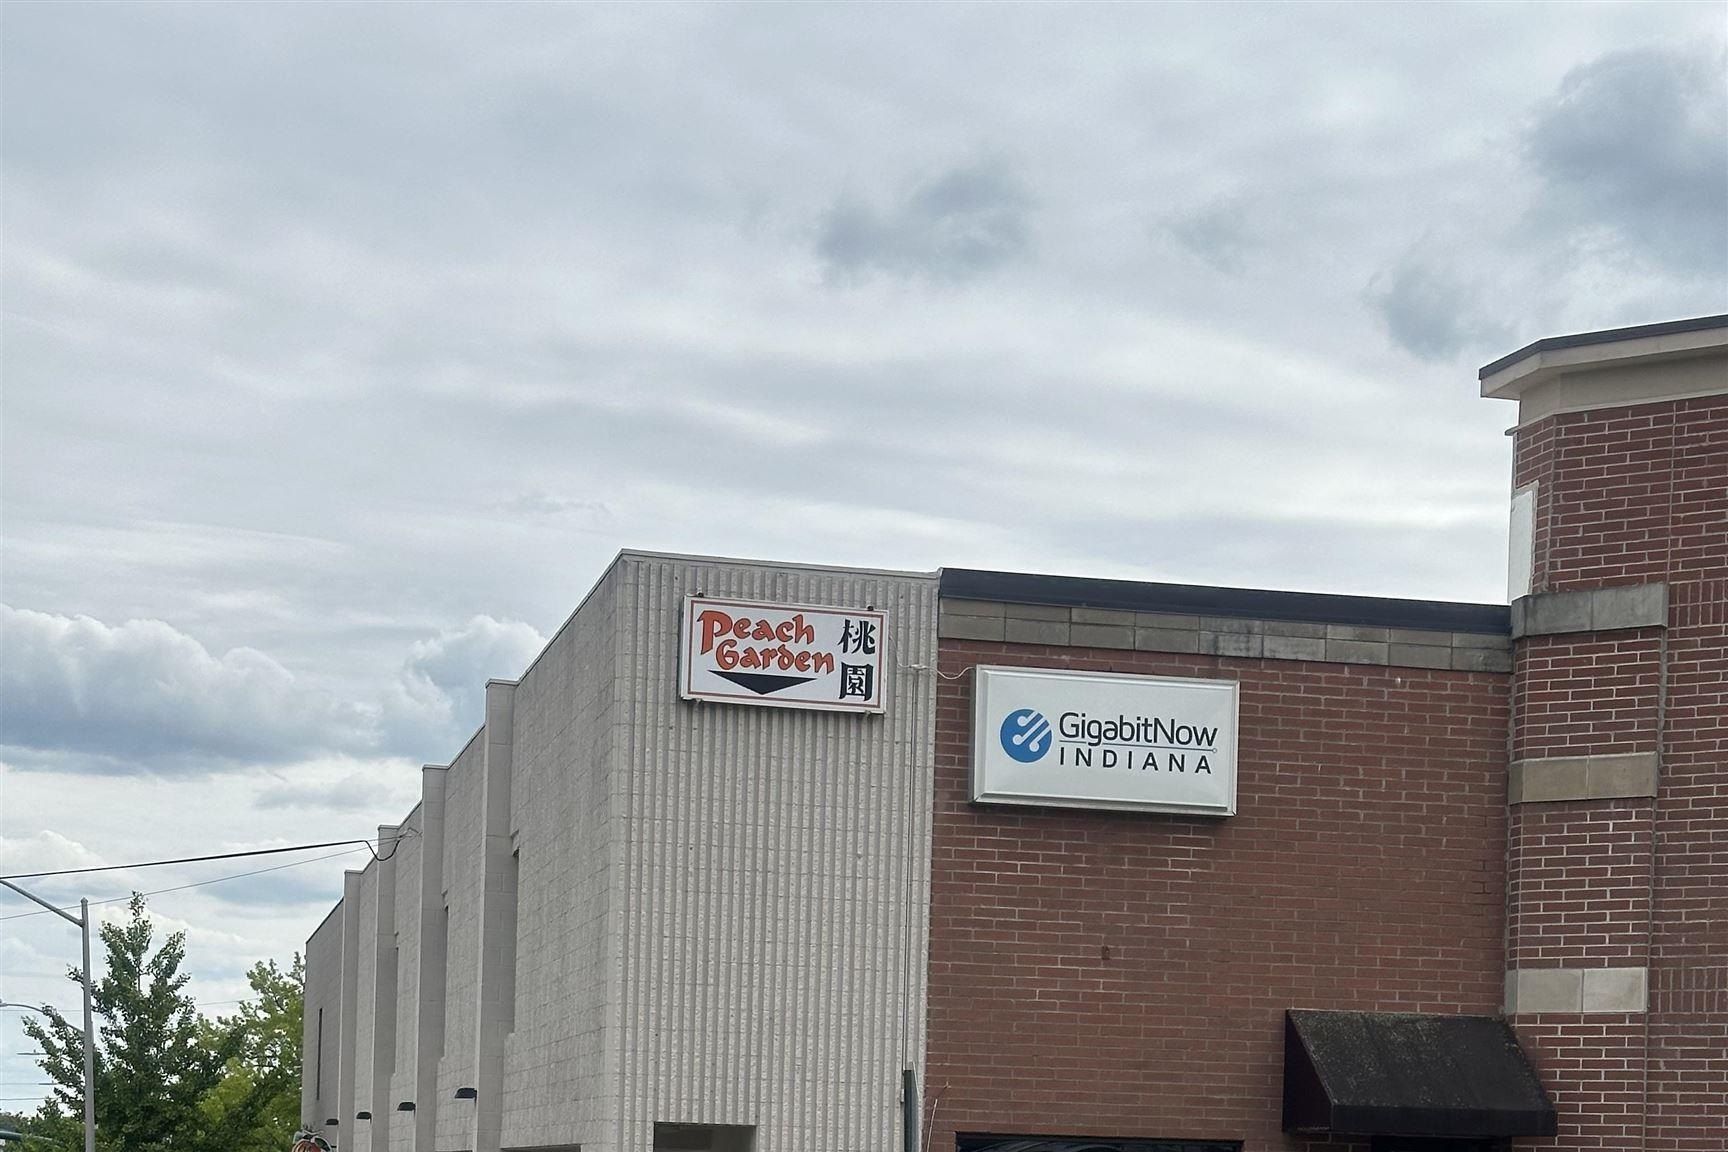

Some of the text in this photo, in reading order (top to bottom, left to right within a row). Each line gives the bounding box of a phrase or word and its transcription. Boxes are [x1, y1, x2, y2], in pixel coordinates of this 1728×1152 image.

[697, 610, 815, 655] Peach
[715, 638, 835, 675] Garden
[837, 619, 877, 702] 桃園
[1059, 711, 1218, 747] GigabitNow
[1059, 747, 1212, 774] INDIANA
